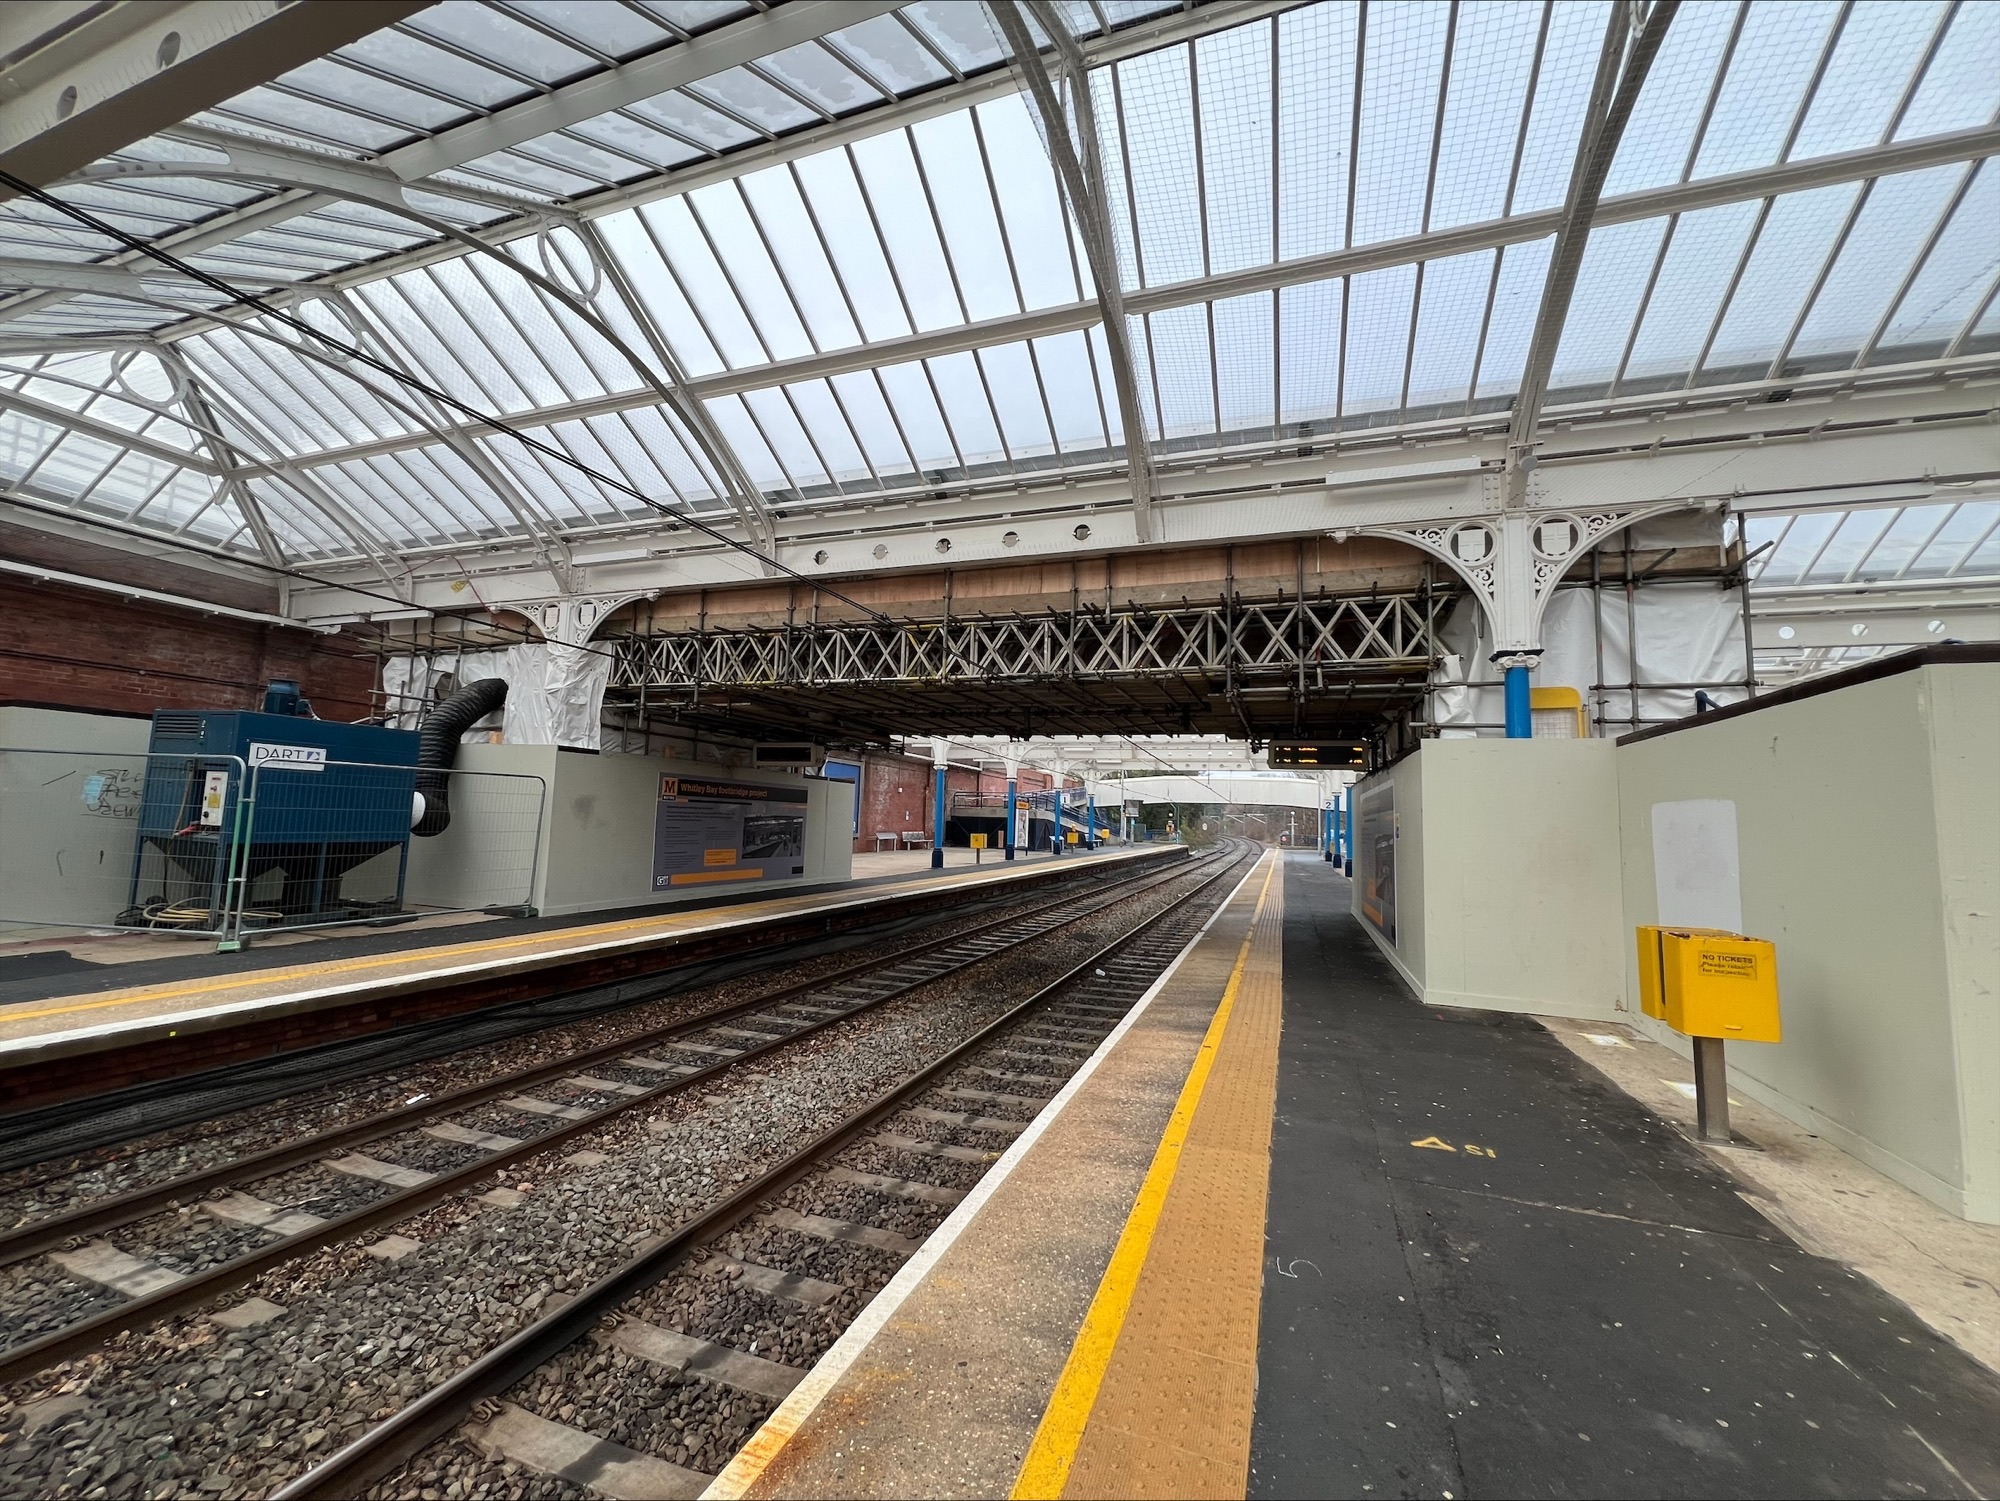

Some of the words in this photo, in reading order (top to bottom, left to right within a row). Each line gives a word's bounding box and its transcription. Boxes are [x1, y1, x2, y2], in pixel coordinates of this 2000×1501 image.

[256, 746, 305, 760] DART
[664, 780, 676, 793] M
[680, 783, 705, 795] Whitley
[706, 785, 718, 795] Bay
[718, 786, 749, 797] footbridge
[749, 789, 768, 798] project
[1325, 801, 1332, 809] 2
[1717, 955, 1753, 964] TICKETS
